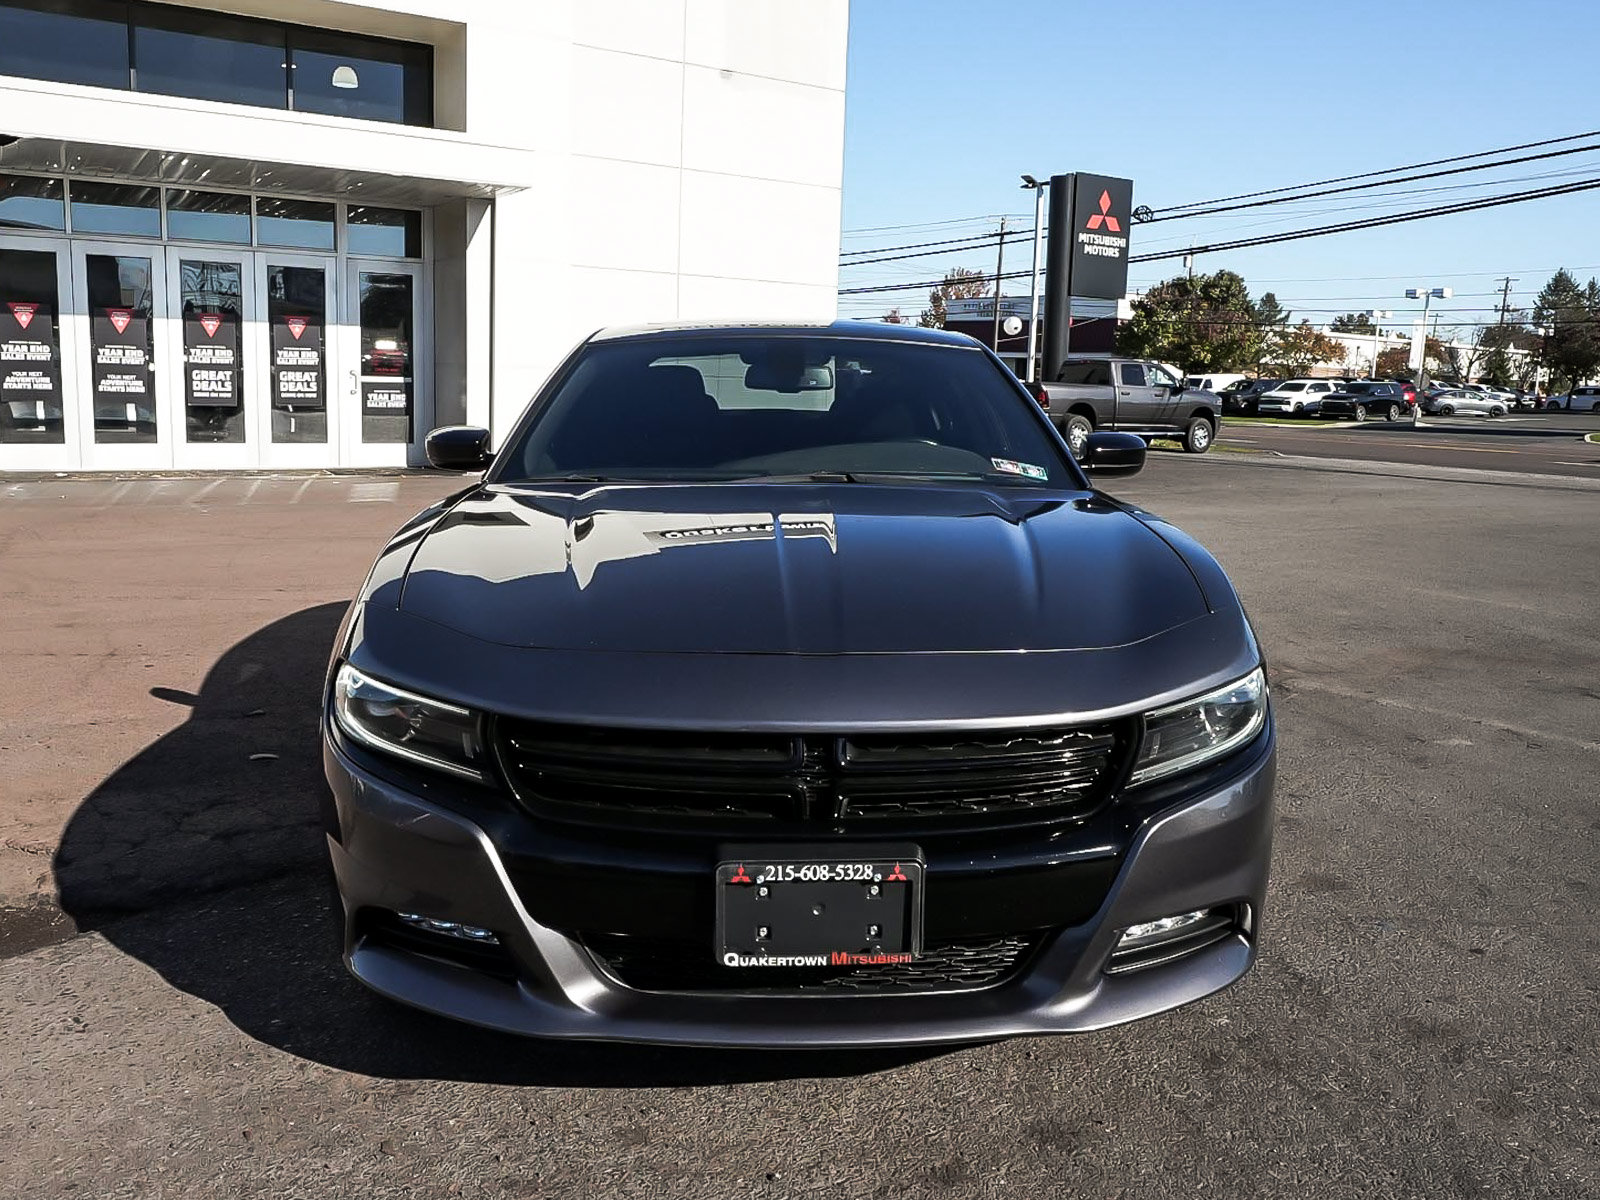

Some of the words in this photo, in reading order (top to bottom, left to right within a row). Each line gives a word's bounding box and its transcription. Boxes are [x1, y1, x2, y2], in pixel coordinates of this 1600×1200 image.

[1078, 232, 1127, 248] MITSUBISHI
[1084, 244, 1120, 257] MOTORS
[1, 344, 29, 353] YEAR
[30, 345, 50, 353] END
[98, 348, 123, 357] YEAR
[125, 349, 144, 358] END
[190, 348, 213, 357] YEAR
[215, 349, 233, 358] END
[277, 350, 299, 358] YEAR
[192, 369, 233, 381] GREAT
[280, 370, 318, 382] GREAT
[192, 380, 232, 392] DEALS
[280, 381, 318, 392] DEALS
[765, 864, 874, 882] 215-608-5328
[723, 952, 828, 968] QUAKERTOWN
[831, 951, 912, 966] MITSUBISHI
